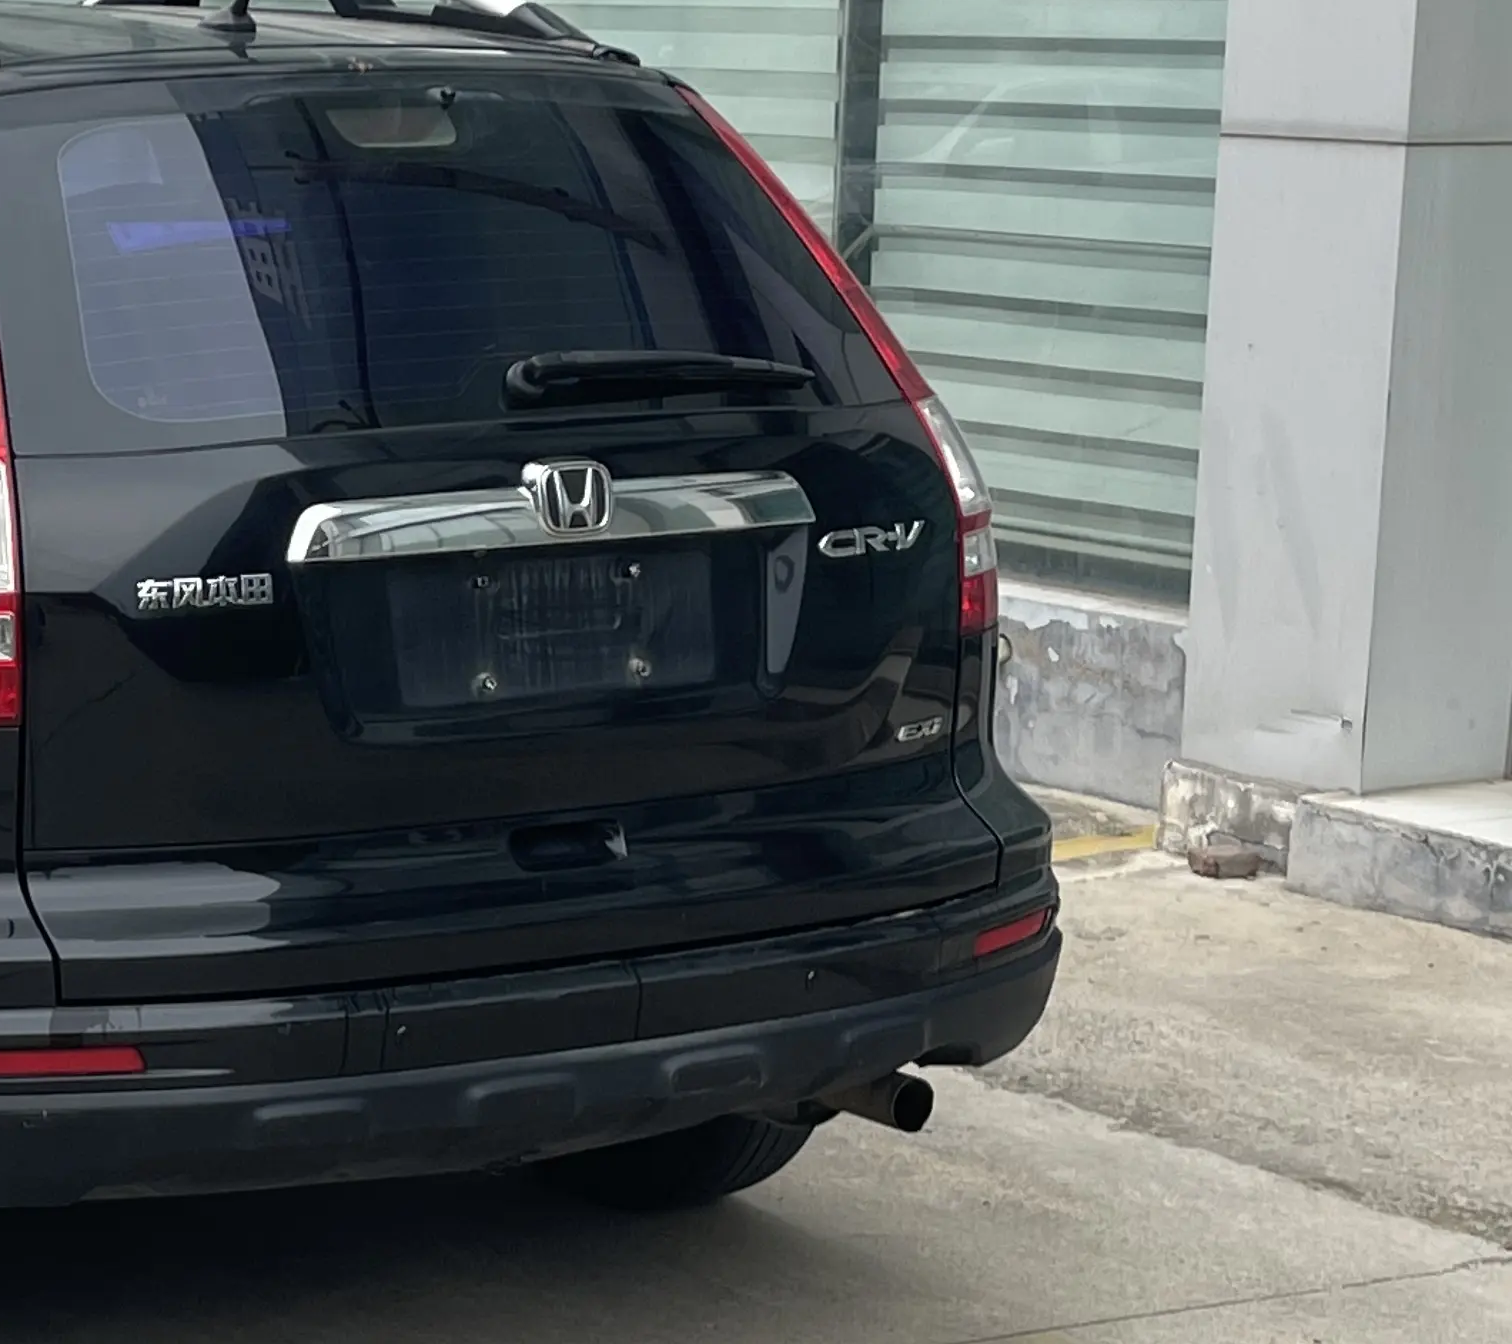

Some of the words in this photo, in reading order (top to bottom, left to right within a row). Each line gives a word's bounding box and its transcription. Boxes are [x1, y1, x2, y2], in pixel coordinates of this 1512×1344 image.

[817, 519, 925, 558] CR-V
[136, 572, 274, 610] 东风本田
